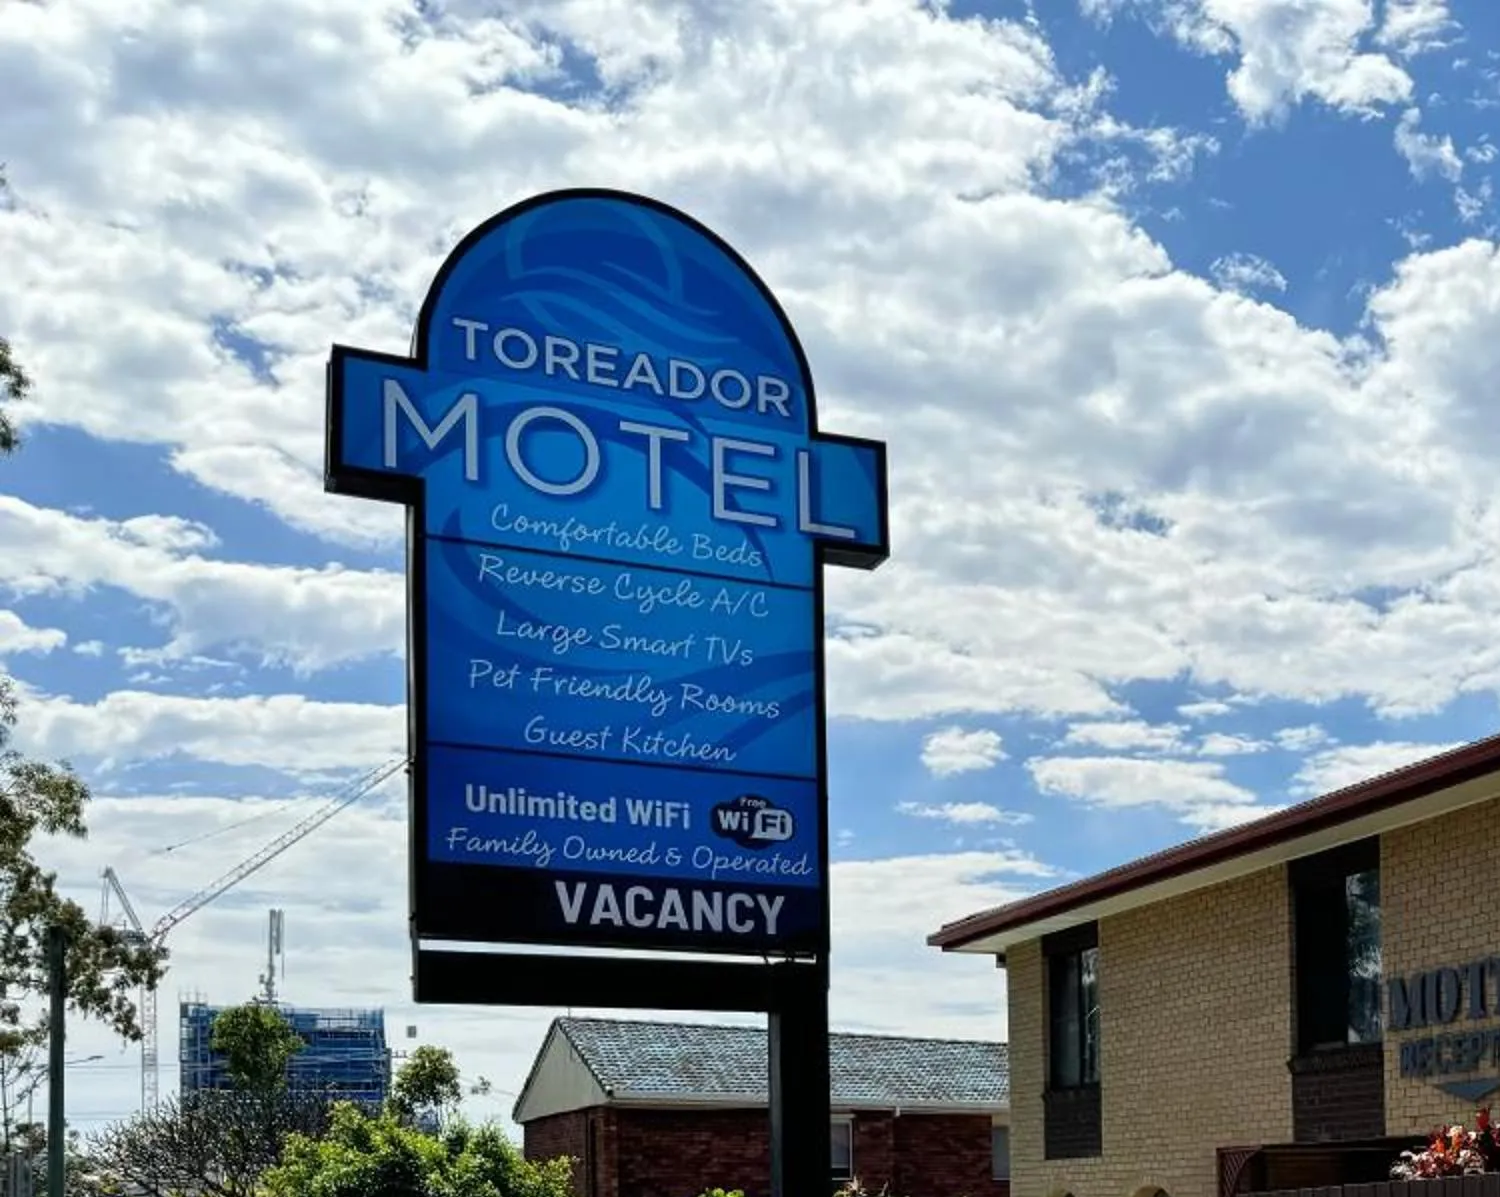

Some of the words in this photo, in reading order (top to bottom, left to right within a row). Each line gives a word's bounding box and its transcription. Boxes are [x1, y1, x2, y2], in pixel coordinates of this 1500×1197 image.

[453, 318, 792, 417] TOREADOR
[383, 379, 856, 539] MOTEL
[491, 503, 683, 554] Comfortable
[692, 533, 764, 567] Beds
[478, 553, 606, 595] Reverse
[614, 572, 704, 613] Cycle
[712, 591, 770, 617] A/C
[497, 610, 592, 654] Large
[599, 624, 694, 658] Smart
[704, 637, 754, 667] TVs
[469, 658, 521, 689] Pet
[530, 666, 673, 716] Friendly
[680, 683, 780, 719] Rooms
[524, 715, 613, 751] Guest
[622, 730, 737, 762] Kitchen
[465, 783, 617, 824] Unlimited
[626, 798, 691, 830] WiFi
[445, 826, 556, 866] Family
[563, 835, 660, 866] Owned
[664, 847, 682, 866] &
[692, 845, 814, 878] Operated
[555, 880, 786, 935] VACANCY
